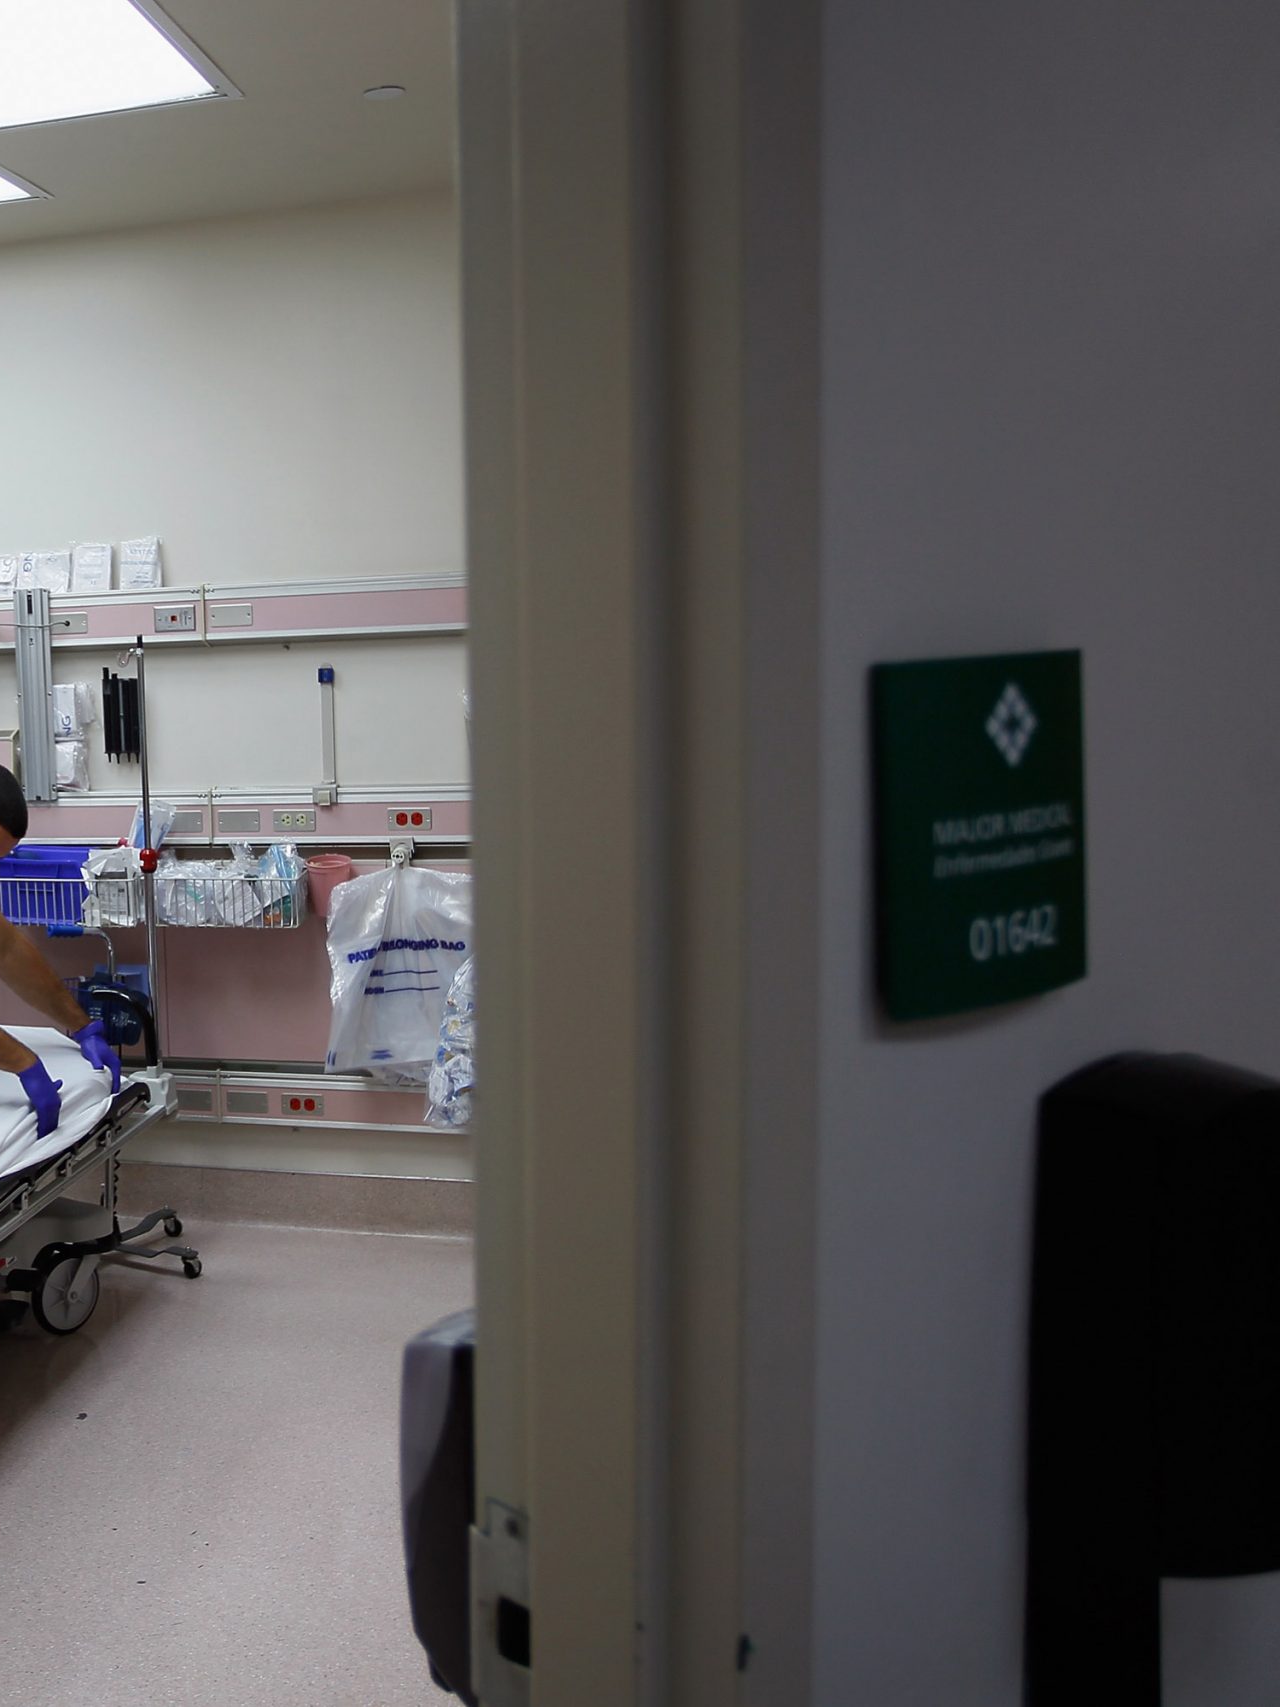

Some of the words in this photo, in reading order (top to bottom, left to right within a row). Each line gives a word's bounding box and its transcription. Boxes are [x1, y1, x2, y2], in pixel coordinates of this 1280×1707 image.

[932, 813, 1005, 845] MAJOR
[440, 940, 466, 951] BAG
[969, 904, 1058, 961] 01642
